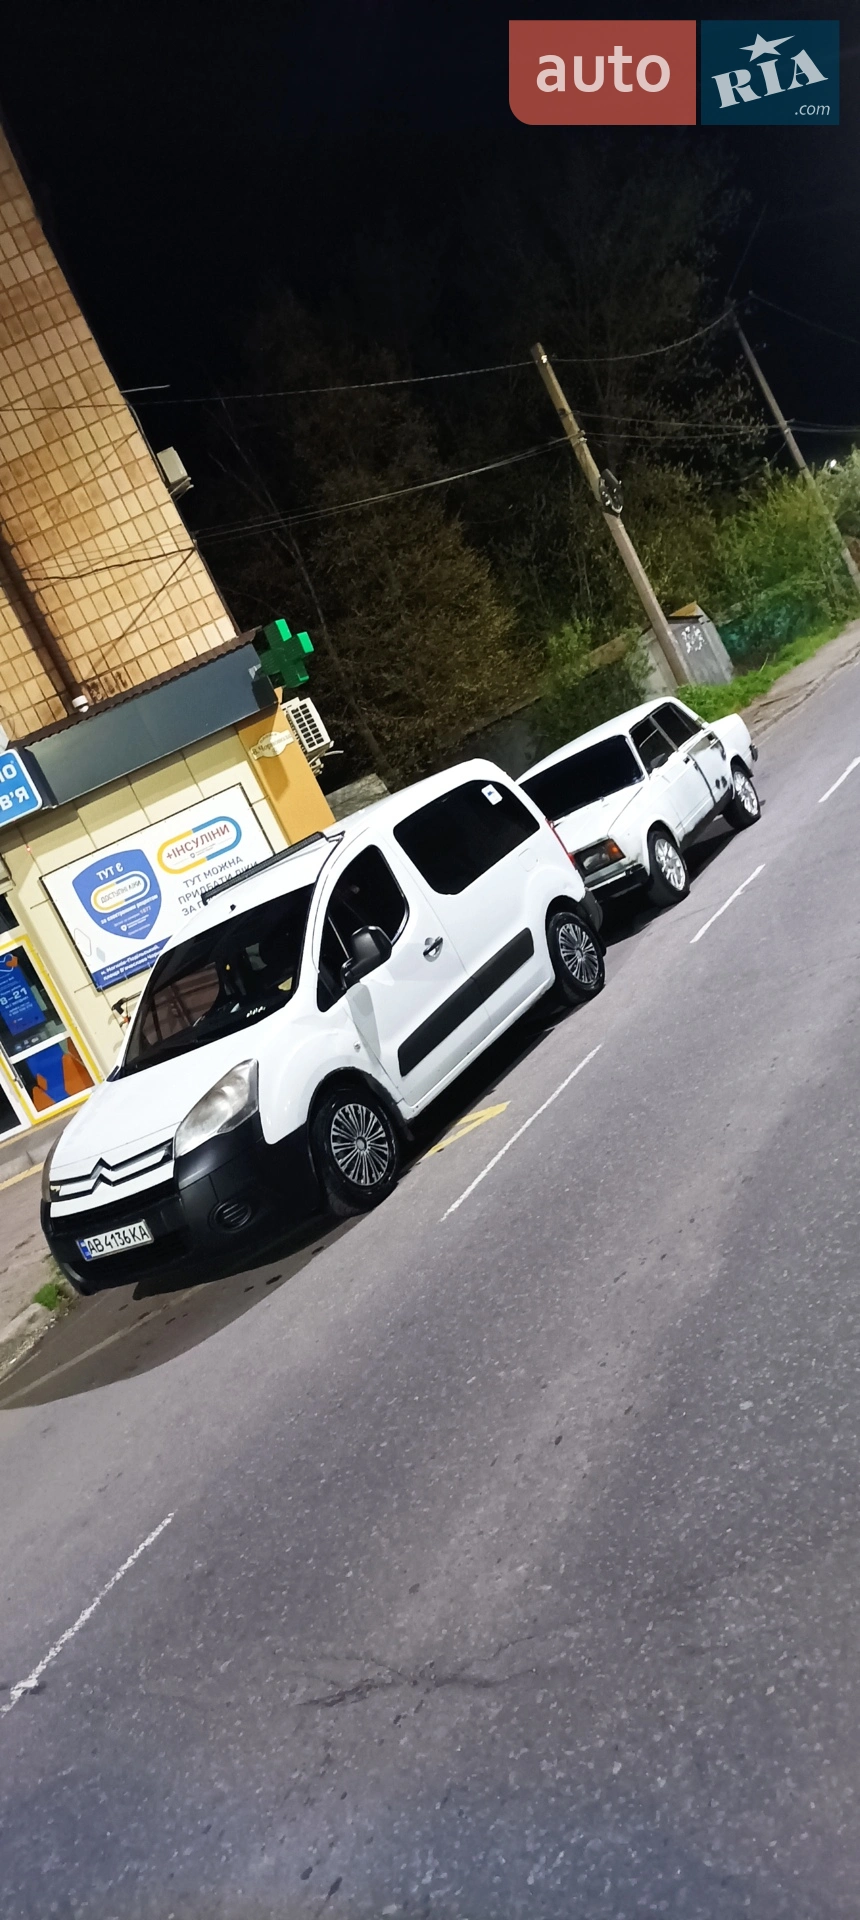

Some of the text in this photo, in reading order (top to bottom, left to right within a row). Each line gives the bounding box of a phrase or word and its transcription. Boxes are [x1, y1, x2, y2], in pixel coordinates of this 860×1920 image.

[95, 865, 115, 881] ТУТ
[183, 873, 202, 888] ТУТ
[203, 856, 244, 879] МОЖНА
[181, 904, 197, 917] ЗА
[87, 1225, 150, 1255] AB 4136 KA
